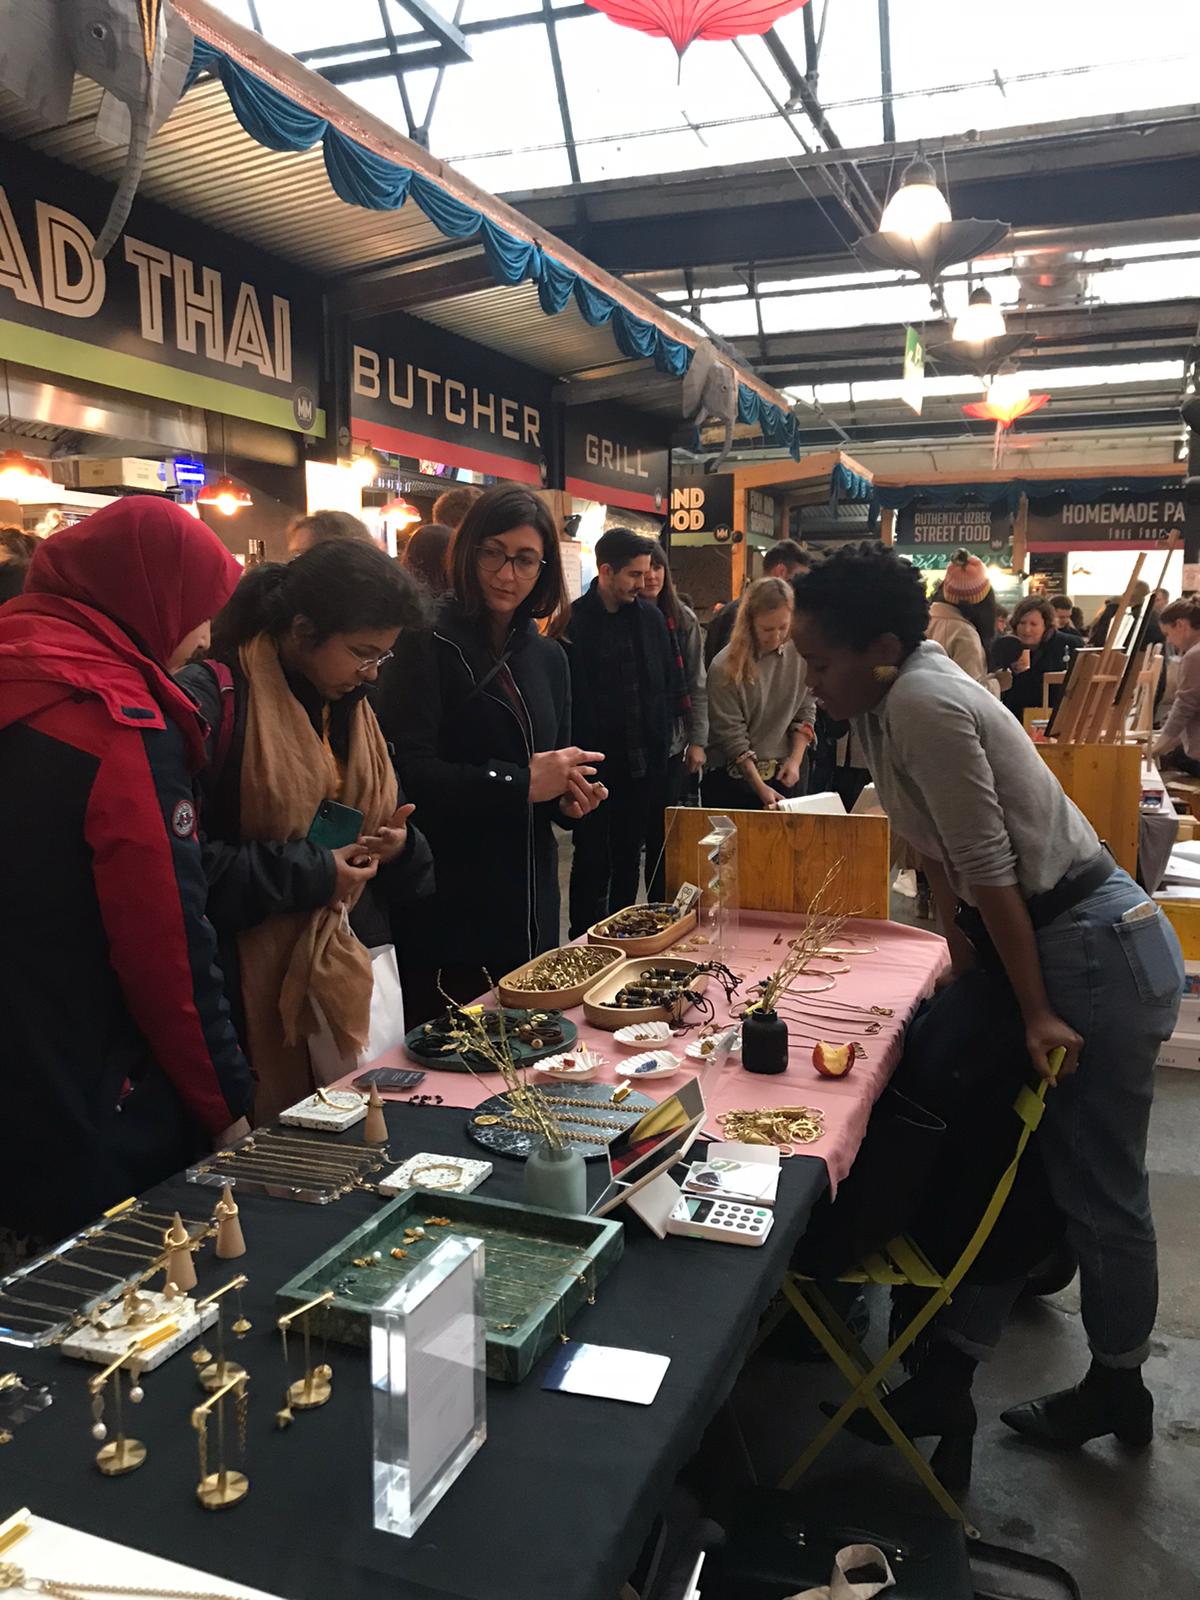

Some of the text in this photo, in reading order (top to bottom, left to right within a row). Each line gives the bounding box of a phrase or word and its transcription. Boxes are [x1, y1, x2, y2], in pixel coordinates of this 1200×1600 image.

[124, 235, 292, 383] THAI
[353, 344, 541, 448] BUTCHER
[586, 434, 648, 478] GRILL
[671, 488, 705, 510] ND
[671, 510, 705, 531] OD
[914, 511, 992, 525] AUTHENTIC UZBEK
[1062, 502, 1159, 524] HOMEMADE
[914, 524, 991, 543] STREET FOOD
